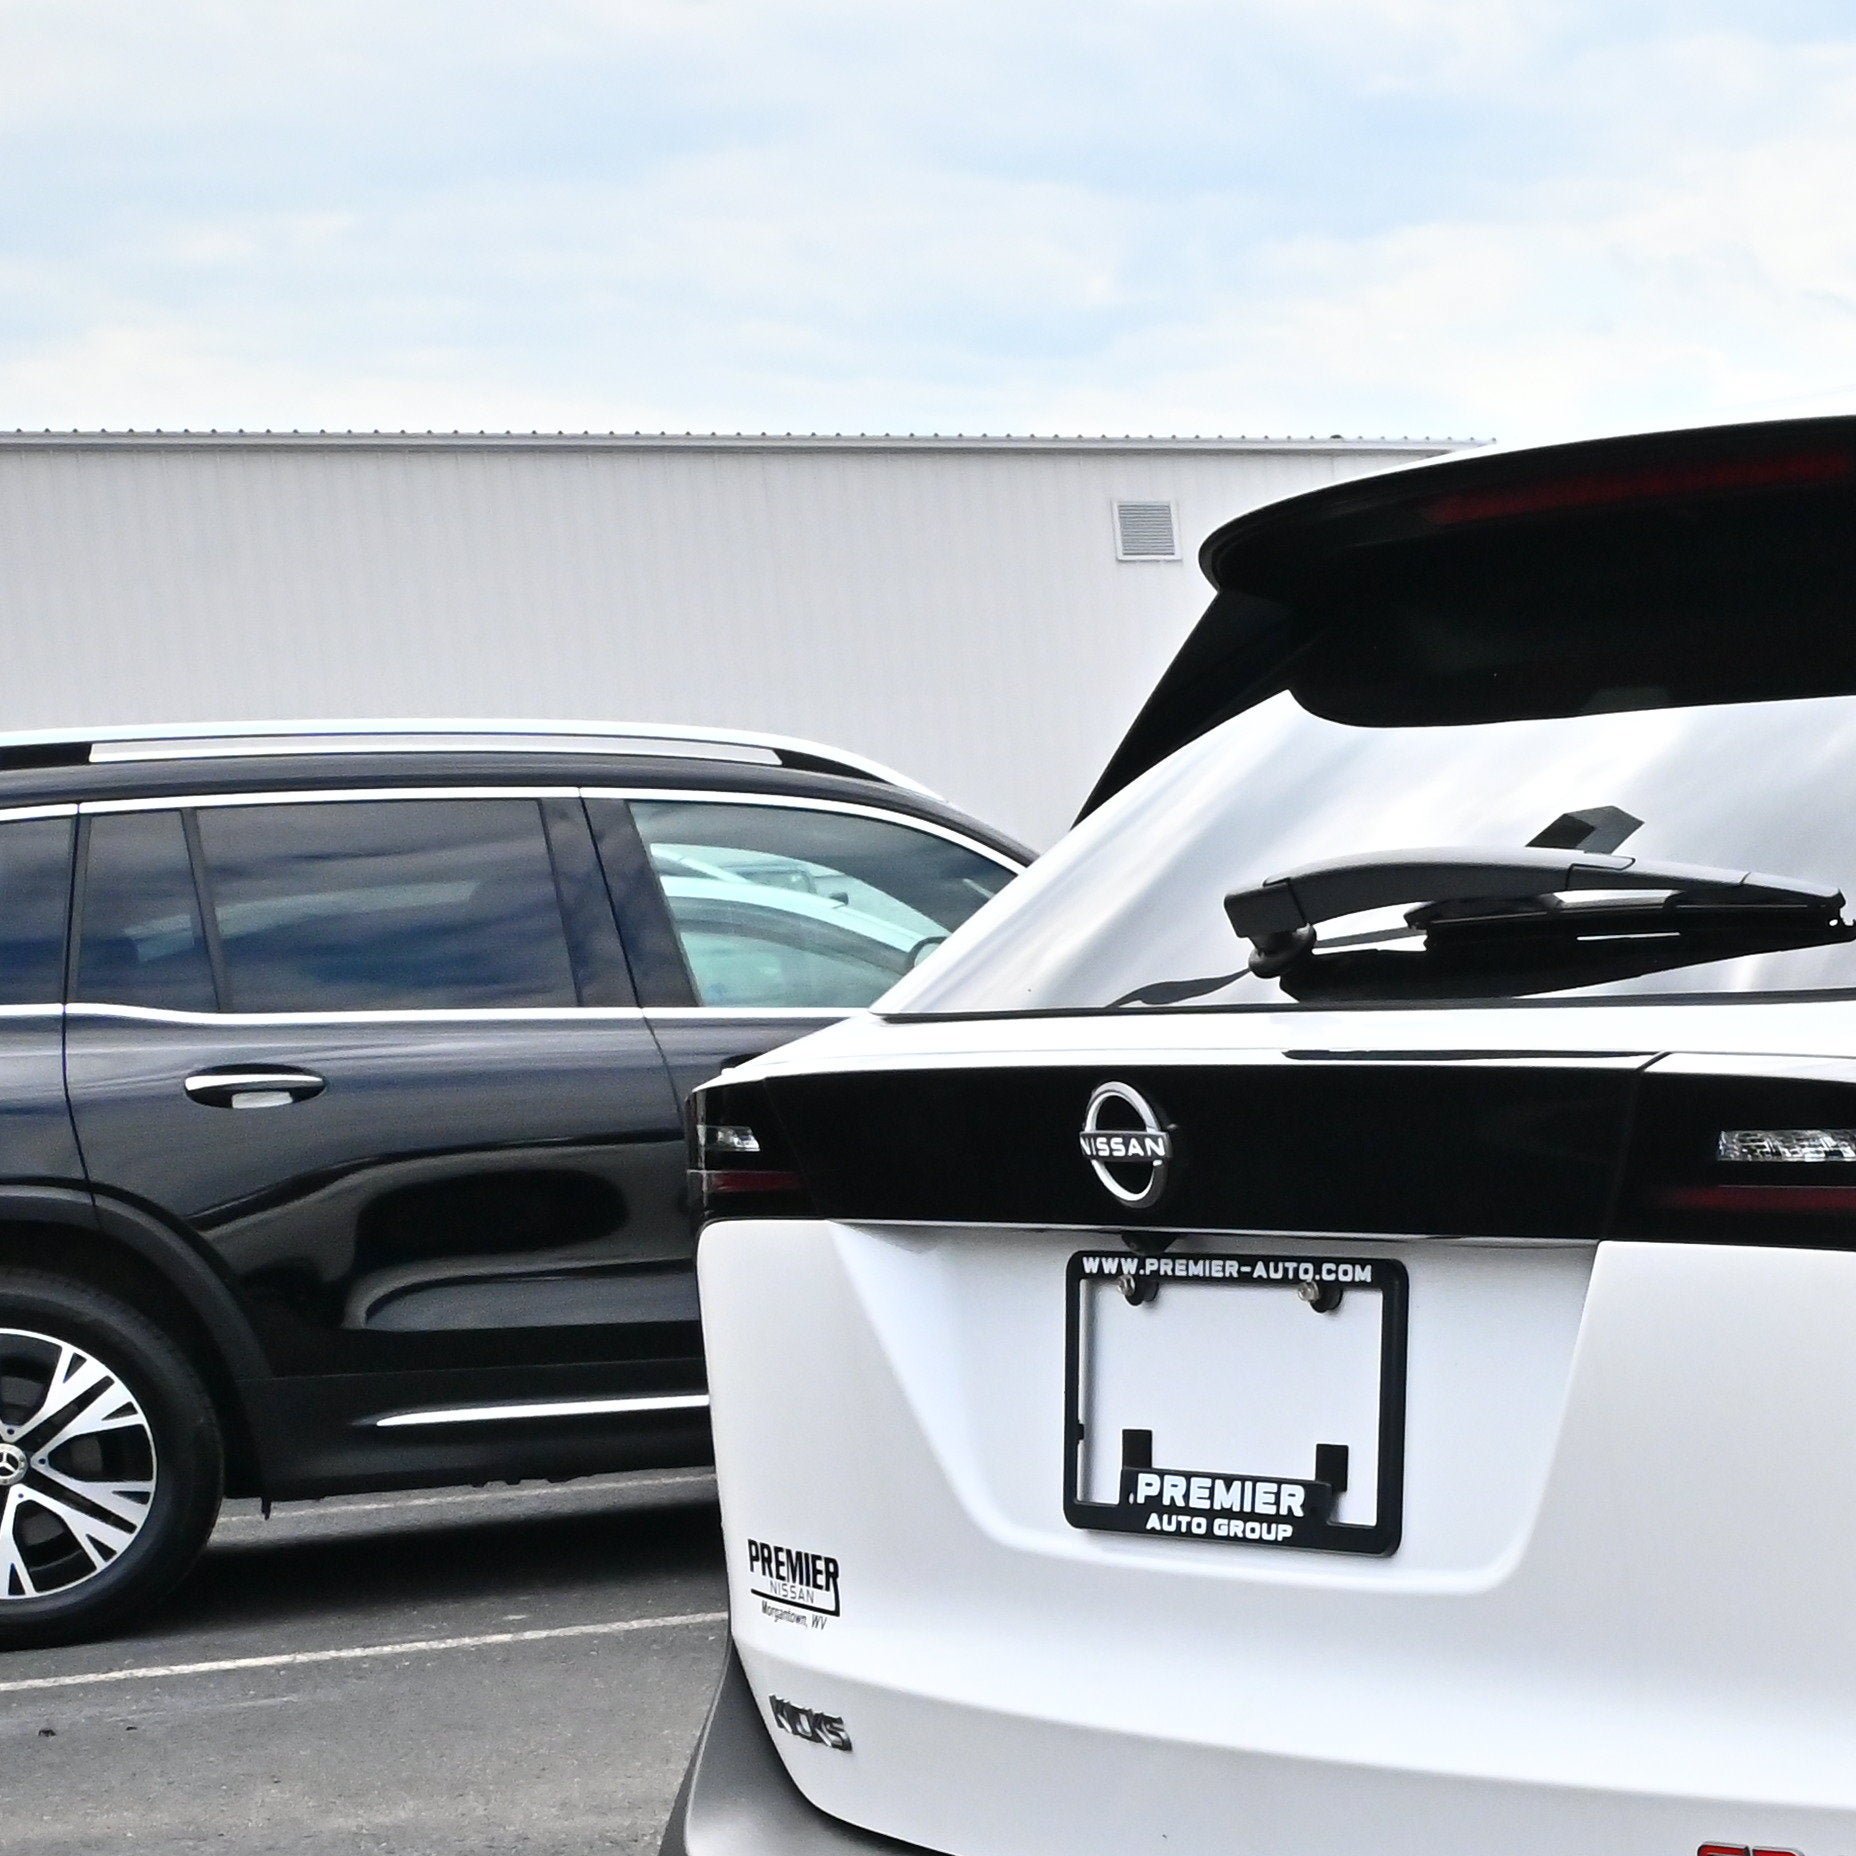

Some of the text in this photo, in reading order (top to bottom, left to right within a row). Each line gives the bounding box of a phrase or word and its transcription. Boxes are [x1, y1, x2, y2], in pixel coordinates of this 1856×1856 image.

[1080, 1137, 1166, 1157] NISSAN
[1082, 1256, 1372, 1283] WWW.PREMIER-AUTO.COM
[1136, 1473, 1306, 1518] PREMIER
[1146, 1512, 1293, 1541] AUTO GROUP
[747, 1538, 840, 1594] PREMIER
[769, 1579, 815, 1604] NISSAN
[811, 1613, 828, 1631] WV
